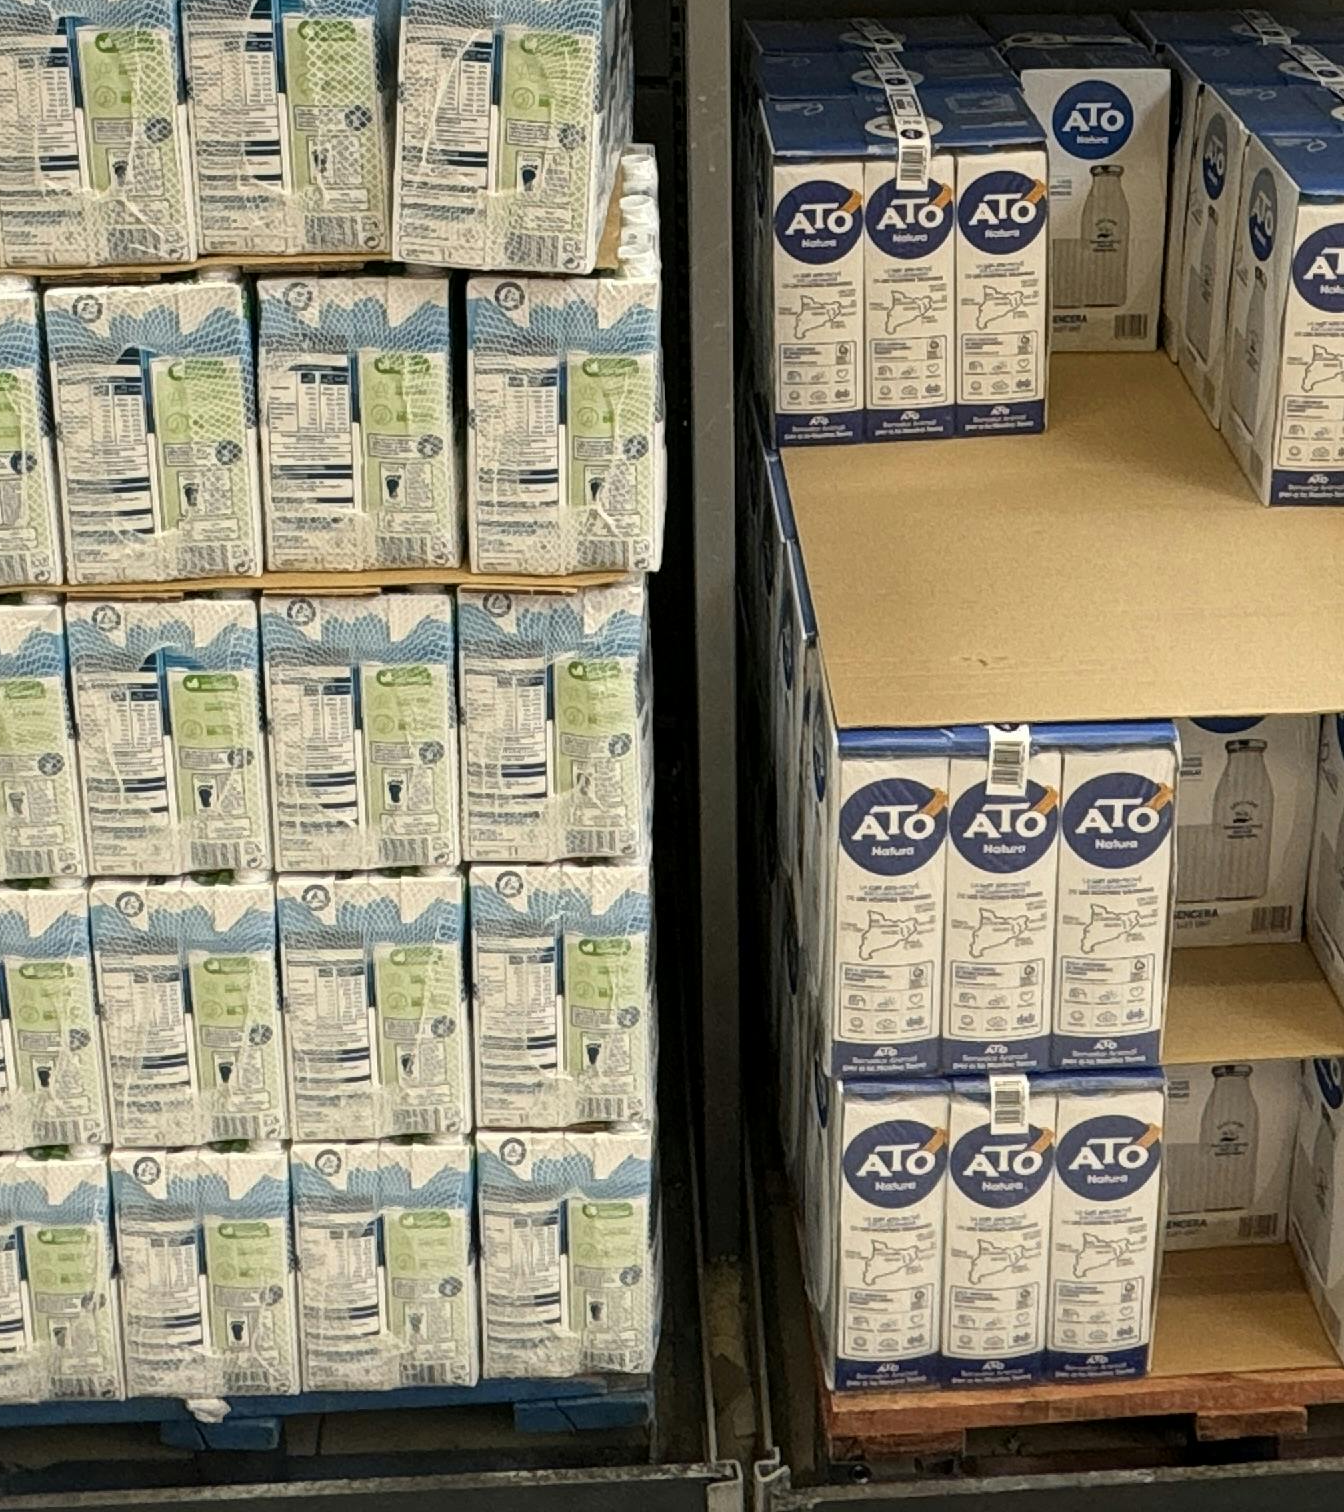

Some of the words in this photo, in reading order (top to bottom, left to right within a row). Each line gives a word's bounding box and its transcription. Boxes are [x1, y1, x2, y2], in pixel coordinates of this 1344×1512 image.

[1062, 102, 1125, 133] ATO
[785, 203, 854, 236] ATO
[877, 197, 944, 230] ATO
[969, 192, 1037, 225] ATO
[851, 804, 936, 841] ATO
[963, 802, 1048, 839] ATO
[1074, 797, 1160, 835] ATO
[1068, 1137, 1150, 1171] ATO
